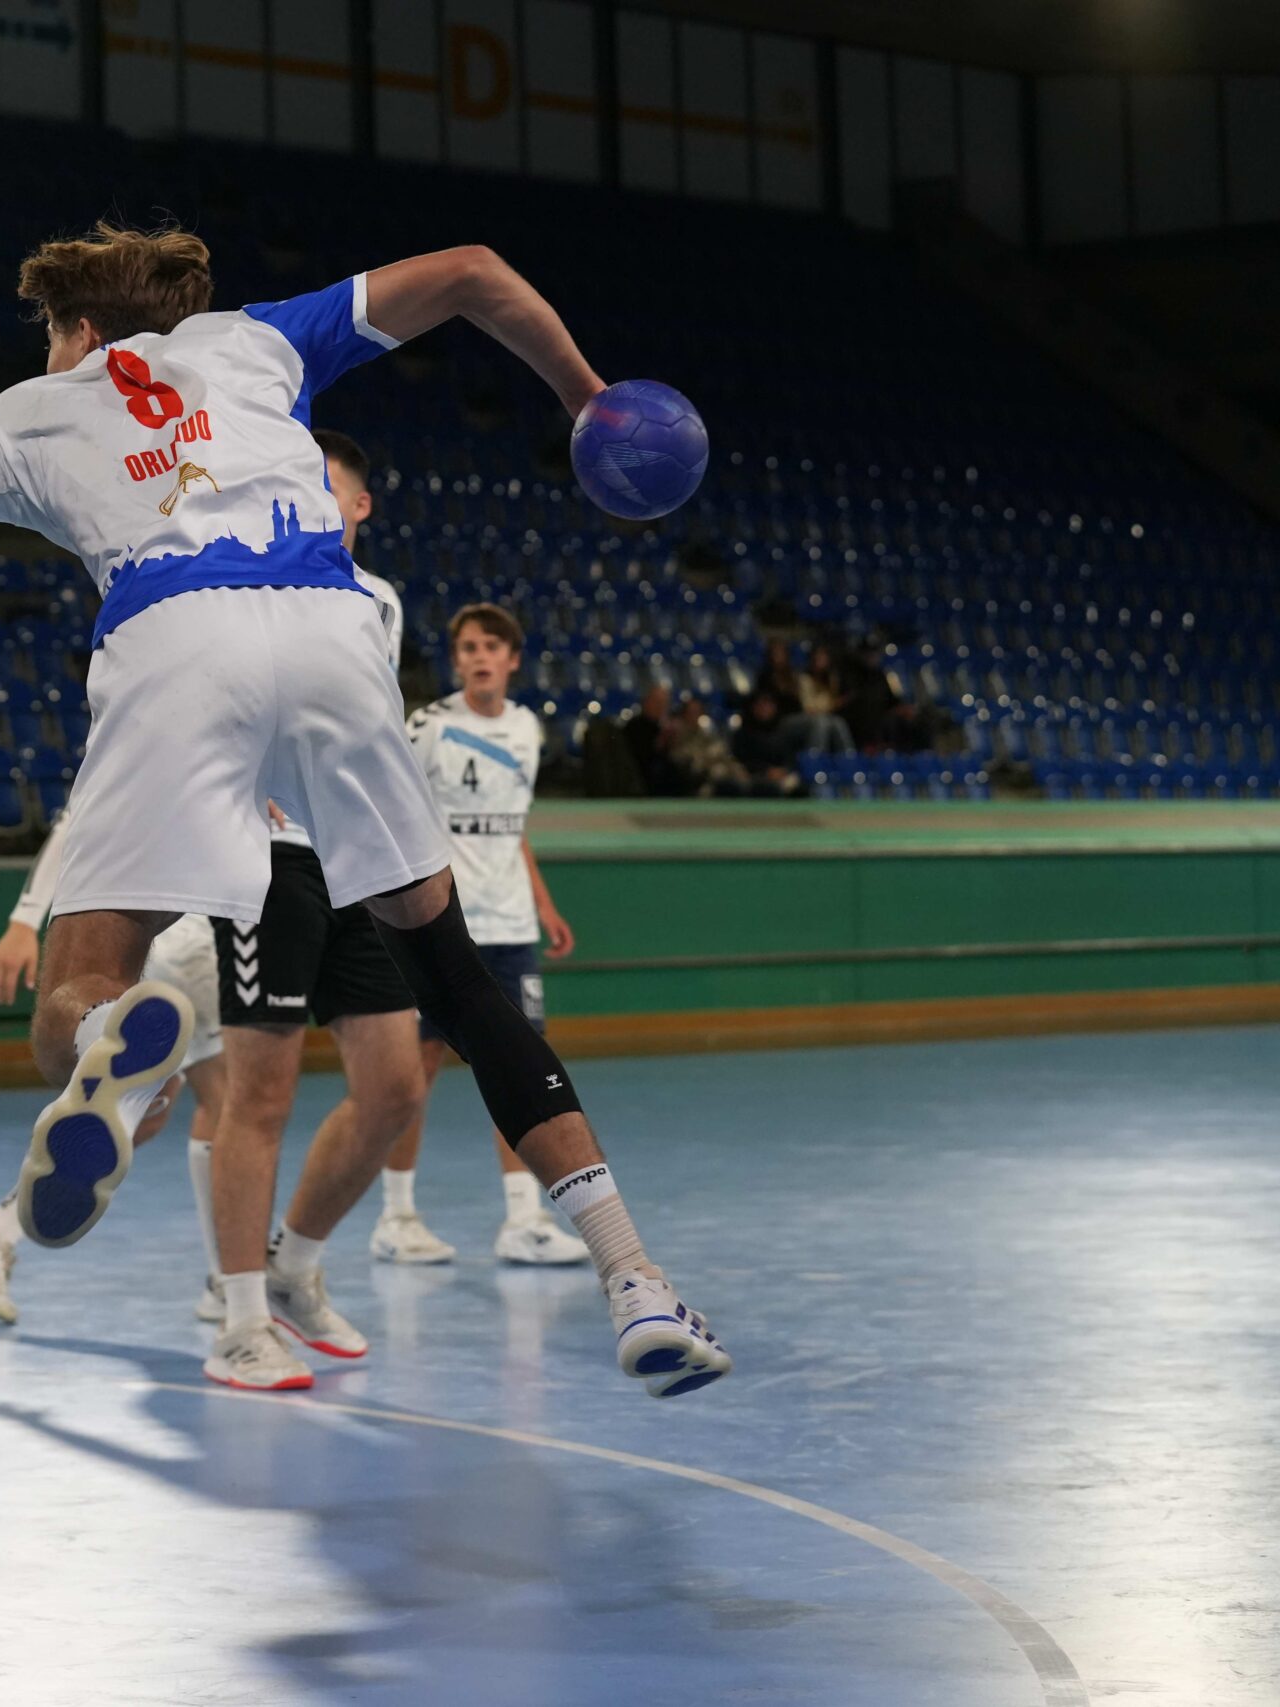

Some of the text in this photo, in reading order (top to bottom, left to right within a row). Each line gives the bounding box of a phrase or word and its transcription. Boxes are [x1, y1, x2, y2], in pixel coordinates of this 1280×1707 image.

[449, 26, 510, 119] D
[107, 348, 184, 430] 8
[462, 757, 478, 793] 4
[549, 1167, 607, 1202] Kempa
